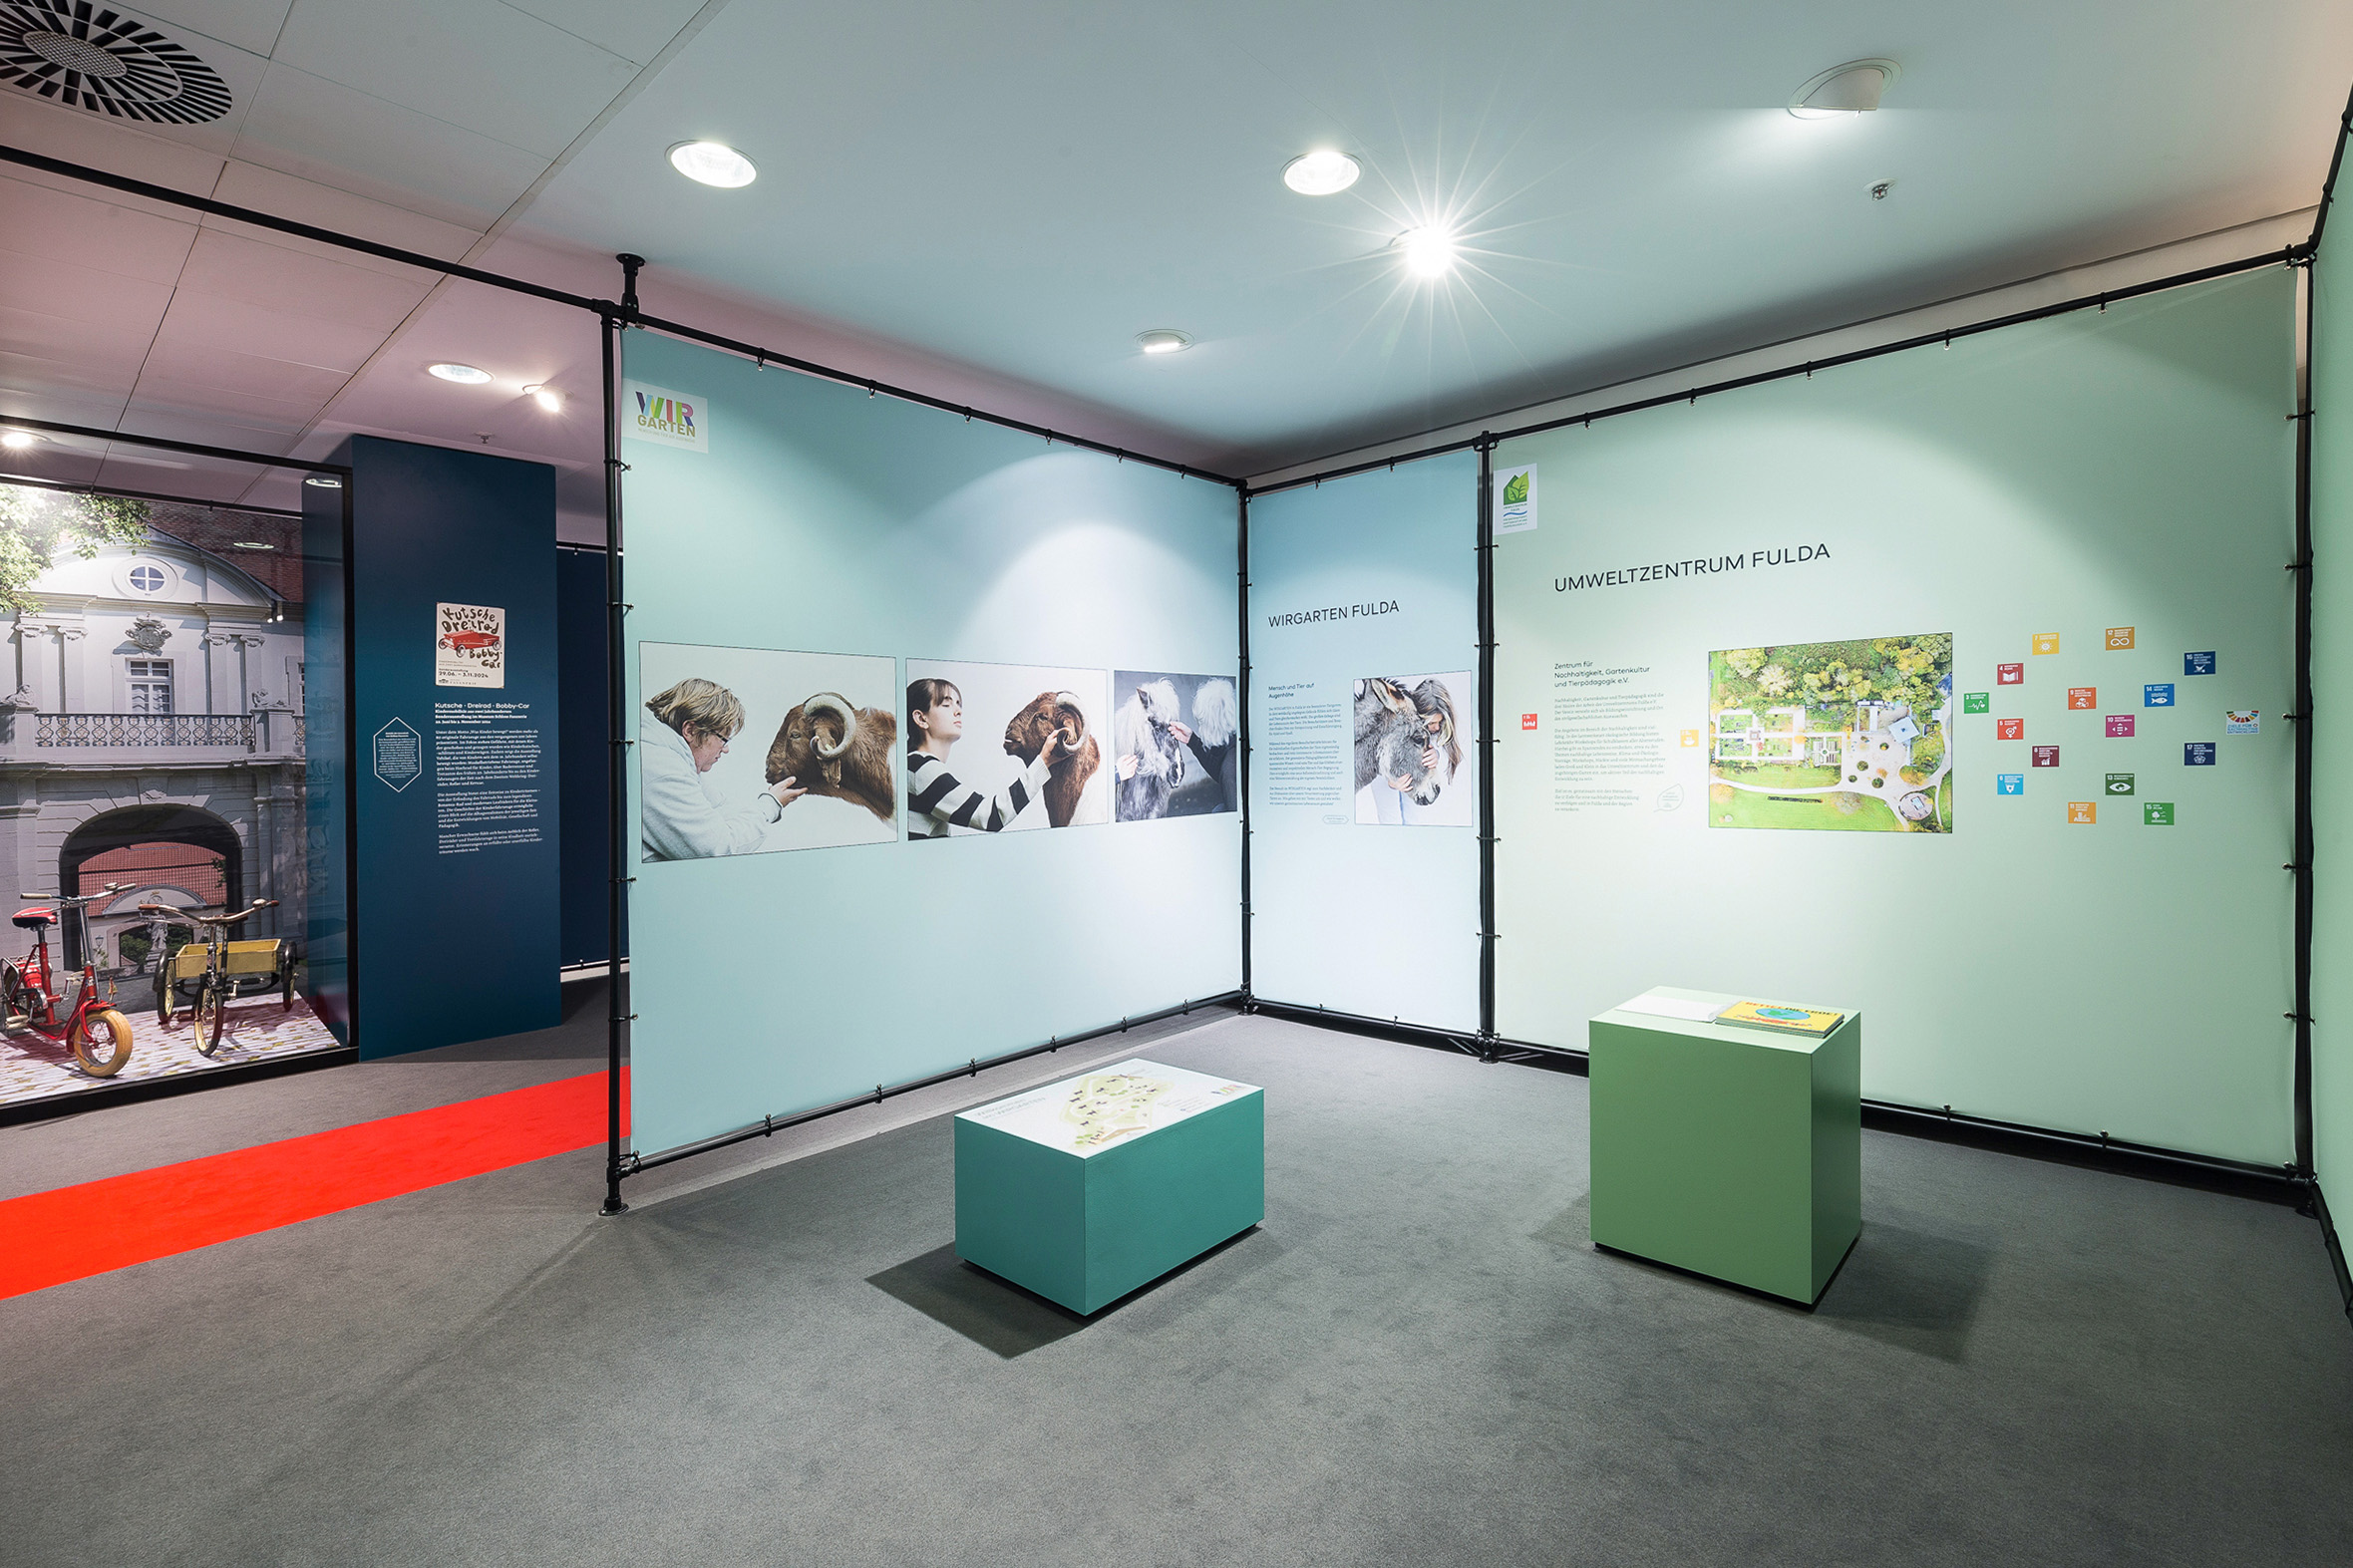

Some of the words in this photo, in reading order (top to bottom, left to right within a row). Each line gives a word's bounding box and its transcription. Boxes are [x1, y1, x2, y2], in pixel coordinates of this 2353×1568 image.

[635, 391, 694, 427] WIR
[637, 415, 696, 437] GARTEN
[1554, 554, 1745, 592] UMWELTZENTRUM
[1752, 543, 1832, 568] FULDA
[443, 607, 496, 622] Kutsche
[1268, 606, 1348, 628] WIRGARTEN
[1352, 600, 1400, 618] FULDA
[442, 620, 500, 635] Dreirad
[482, 660, 501, 669] Car
[1554, 670, 1604, 679] Nachhaltigkeit,
[1568, 678, 1616, 687] Tierpädagogik
